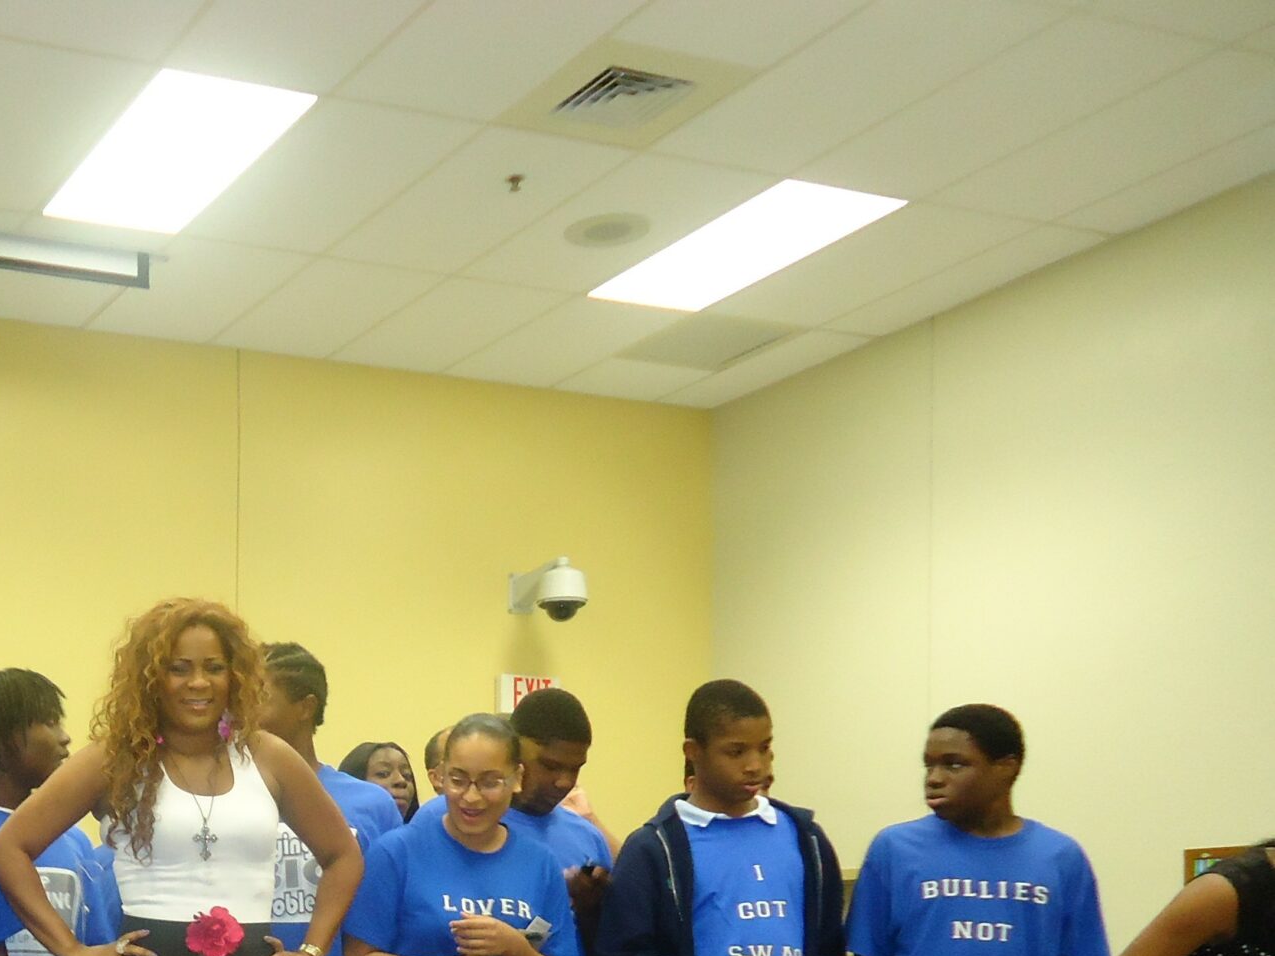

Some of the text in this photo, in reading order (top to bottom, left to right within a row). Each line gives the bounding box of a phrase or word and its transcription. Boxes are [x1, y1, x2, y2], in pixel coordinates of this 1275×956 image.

[753, 864, 765, 882] I
[920, 878, 1051, 905] BULLIES
[442, 893, 533, 921] LOVER
[737, 900, 788, 920] GOT
[951, 920, 1014, 942] NOT
